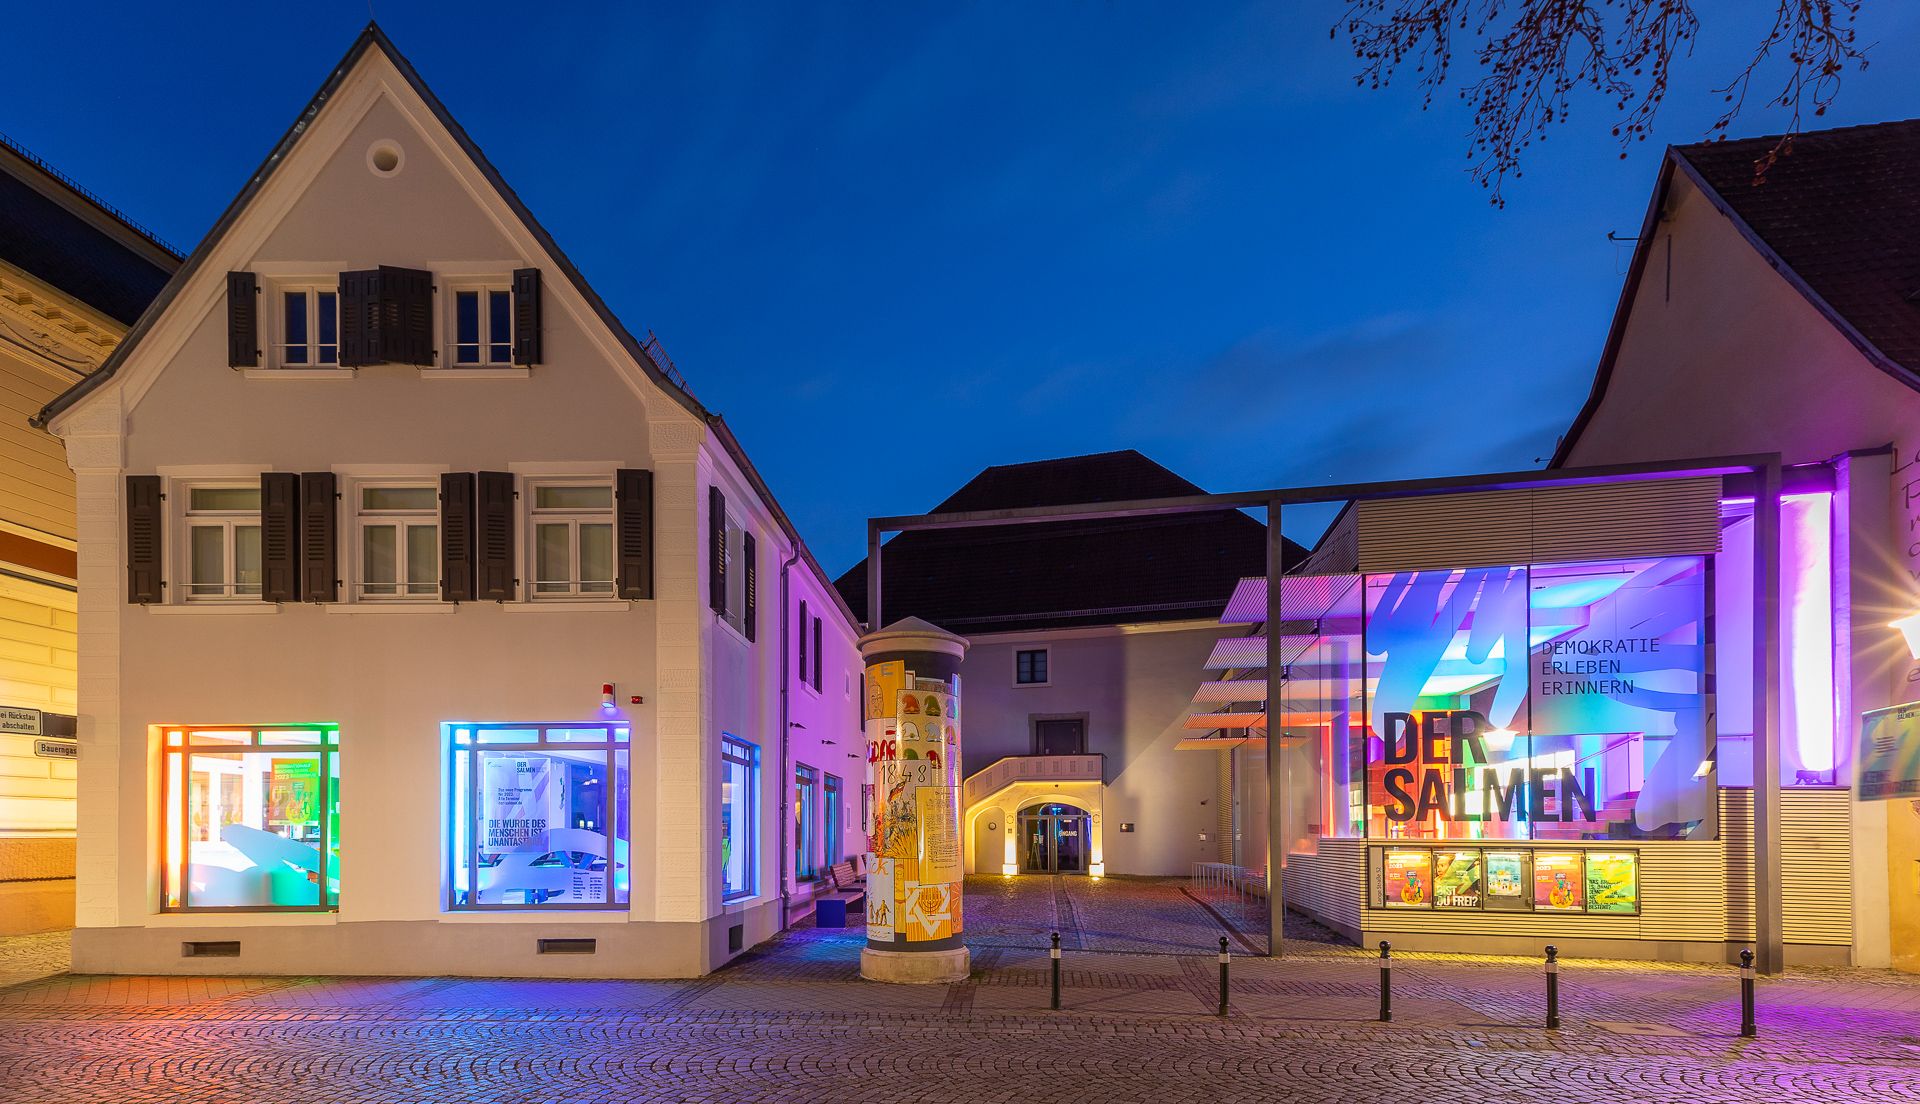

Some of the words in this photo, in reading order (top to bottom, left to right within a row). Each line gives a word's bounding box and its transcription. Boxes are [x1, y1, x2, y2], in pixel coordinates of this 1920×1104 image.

[1541, 638, 1660, 655] DEMOKRATIE
[1541, 660, 1621, 675] ERLEBEN
[1541, 680, 1634, 695] ERINNERN
[8, 711, 35, 720] Rückstau
[2, 722, 35, 731] abschalten
[1384, 711, 1488, 765] DER
[881, 763, 927, 785] 1848
[1384, 767, 1598, 823] SALMEN
[488, 819, 501, 828] DIE
[531, 818, 546, 828] DES
[488, 828, 529, 838] MENSCHEN
[531, 828, 543, 837] IST
[1437, 885, 1458, 895] BIST
[1437, 896, 1451, 906] DU
[1452, 895, 1478, 907] FREI?
